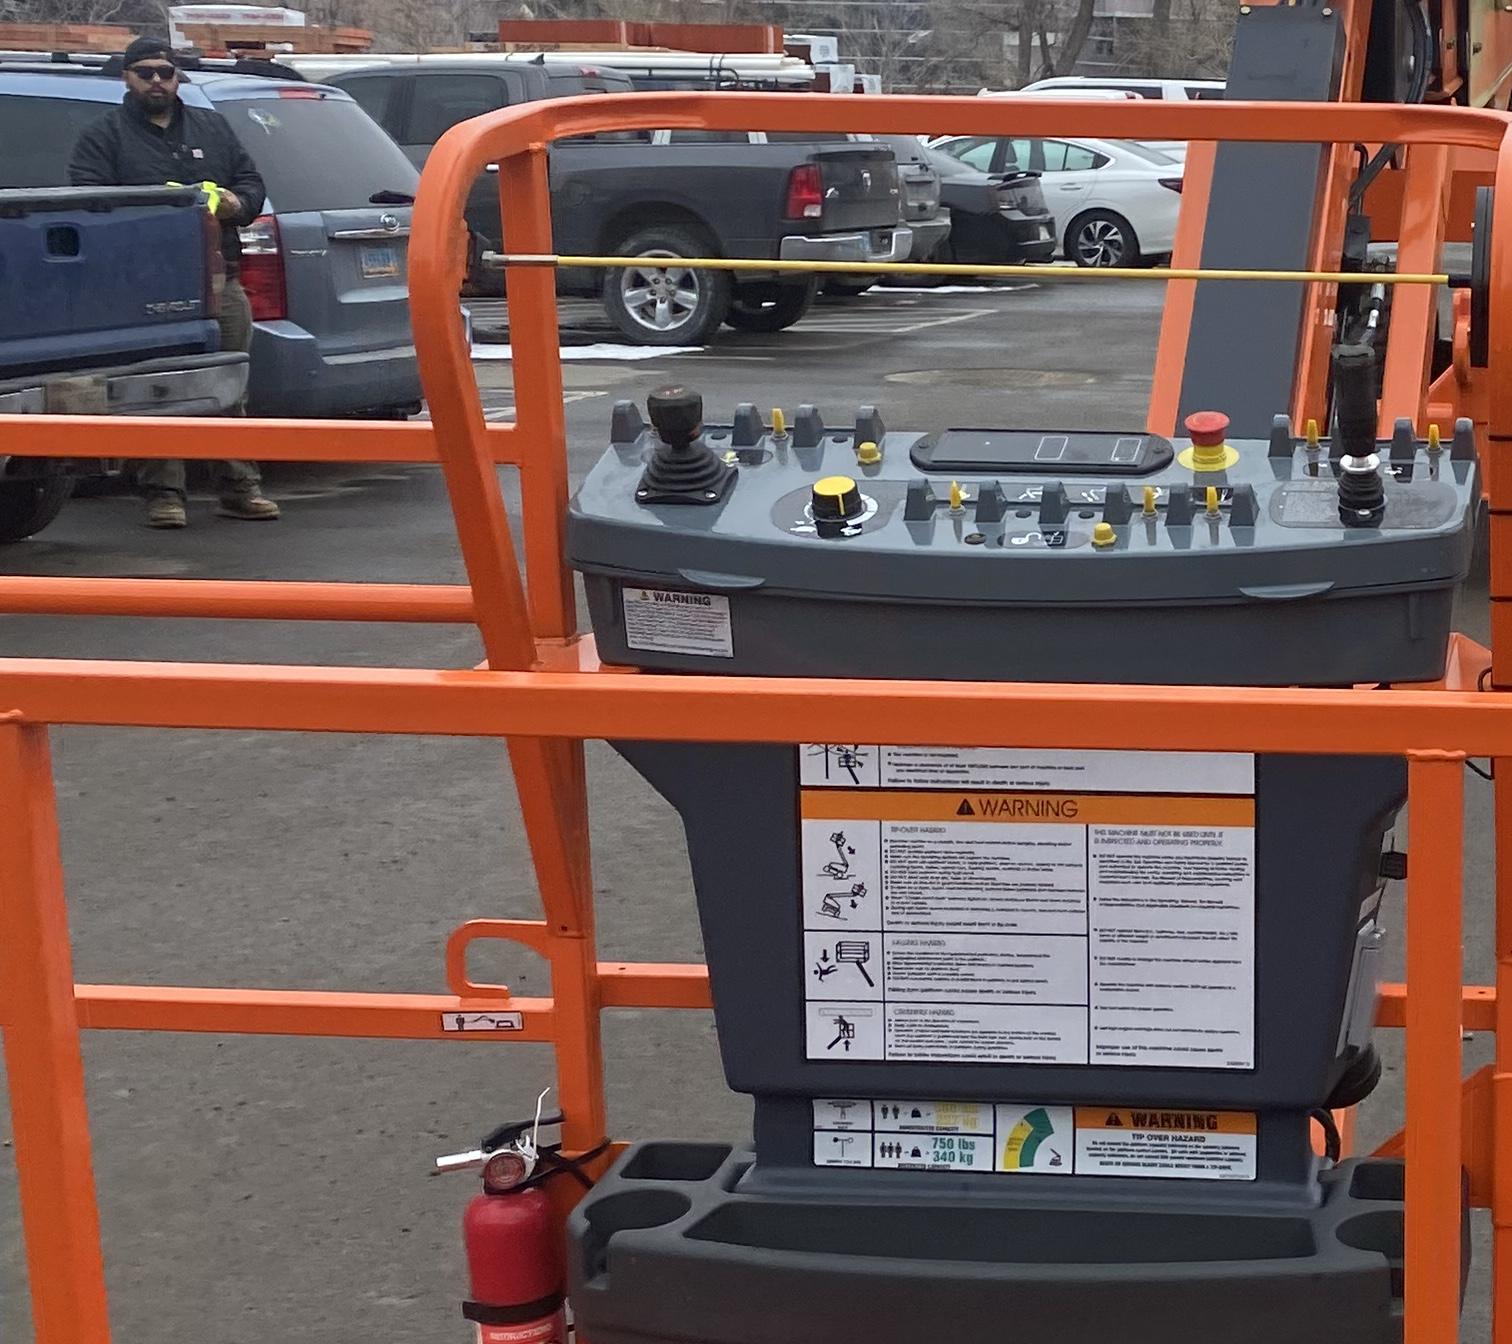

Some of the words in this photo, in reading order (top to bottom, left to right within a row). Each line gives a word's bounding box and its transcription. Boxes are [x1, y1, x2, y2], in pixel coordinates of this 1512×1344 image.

[653, 591, 711, 606] WARNING
[978, 799, 1078, 818] WARNING
[1130, 1112, 1218, 1130] WARNING
[932, 1138, 954, 1149] 750
[958, 1138, 976, 1150] lbs
[933, 1151, 955, 1163] 340
[959, 1151, 973, 1165] kg
